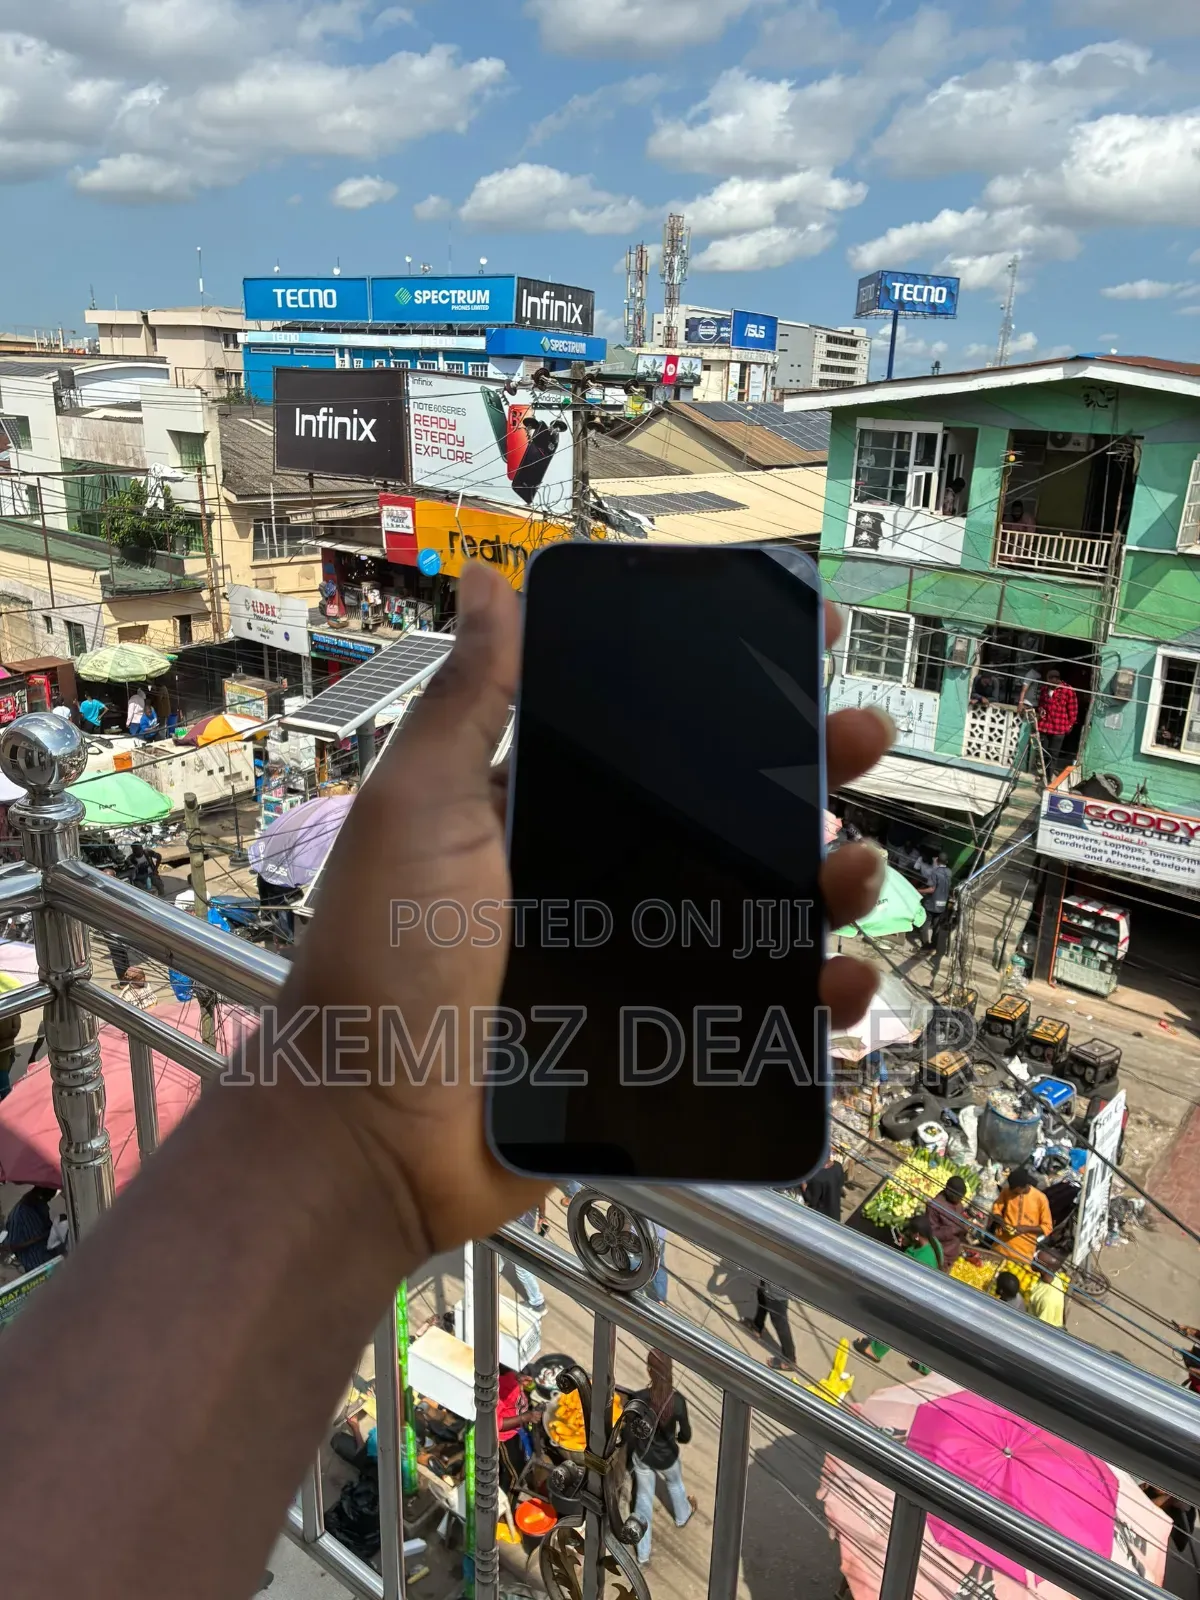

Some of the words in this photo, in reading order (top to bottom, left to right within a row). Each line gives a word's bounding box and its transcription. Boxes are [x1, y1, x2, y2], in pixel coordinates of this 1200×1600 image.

[272, 288, 337, 308] TECNO
[414, 289, 490, 304] SPECTRUM
[891, 282, 947, 303] TECNO
[522, 288, 583, 325] Infinix
[744, 323, 766, 338] ASUS
[550, 338, 586, 355] SPECTRUM
[295, 405, 377, 443] Infinix
[413, 413, 457, 431] READY
[414, 428, 465, 448] STEADY
[415, 443, 474, 465] EXPLORE
[449, 530, 528, 568] realm
[1084, 803, 1200, 839] GODDY
[1049, 828, 1101, 846] Computers,
[1089, 819, 1192, 847] COMPUTER
[1101, 831, 1133, 843] Dealer
[1084, 853, 1103, 862] and
[1111, 850, 1150, 865] Phones,
[1152, 858, 1197, 875] Gadgets
